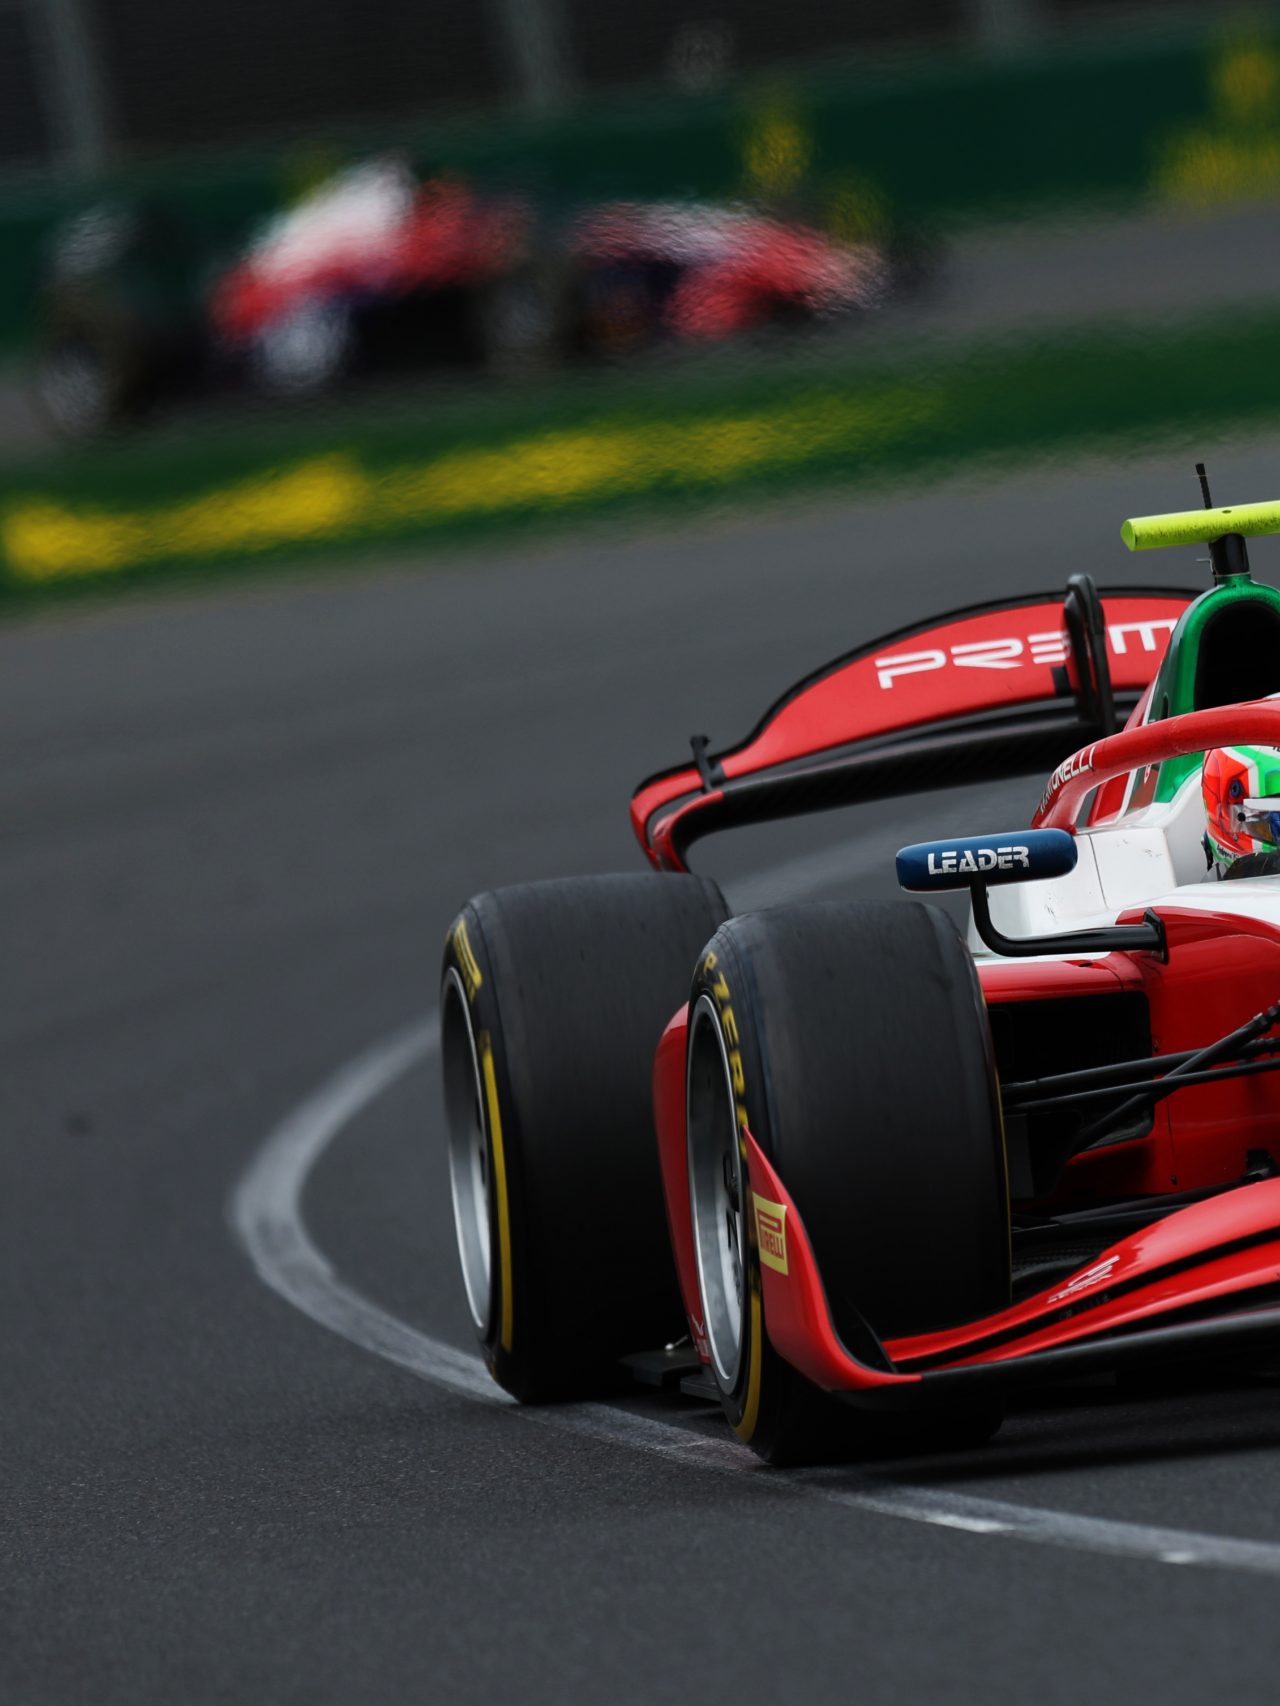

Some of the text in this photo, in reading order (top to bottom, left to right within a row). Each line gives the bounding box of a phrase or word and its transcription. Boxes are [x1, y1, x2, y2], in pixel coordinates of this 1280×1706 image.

[873, 618, 1180, 690] PREM
[927, 846, 1030, 875] LEADER
[756, 1208, 785, 1260] PIRELLI
